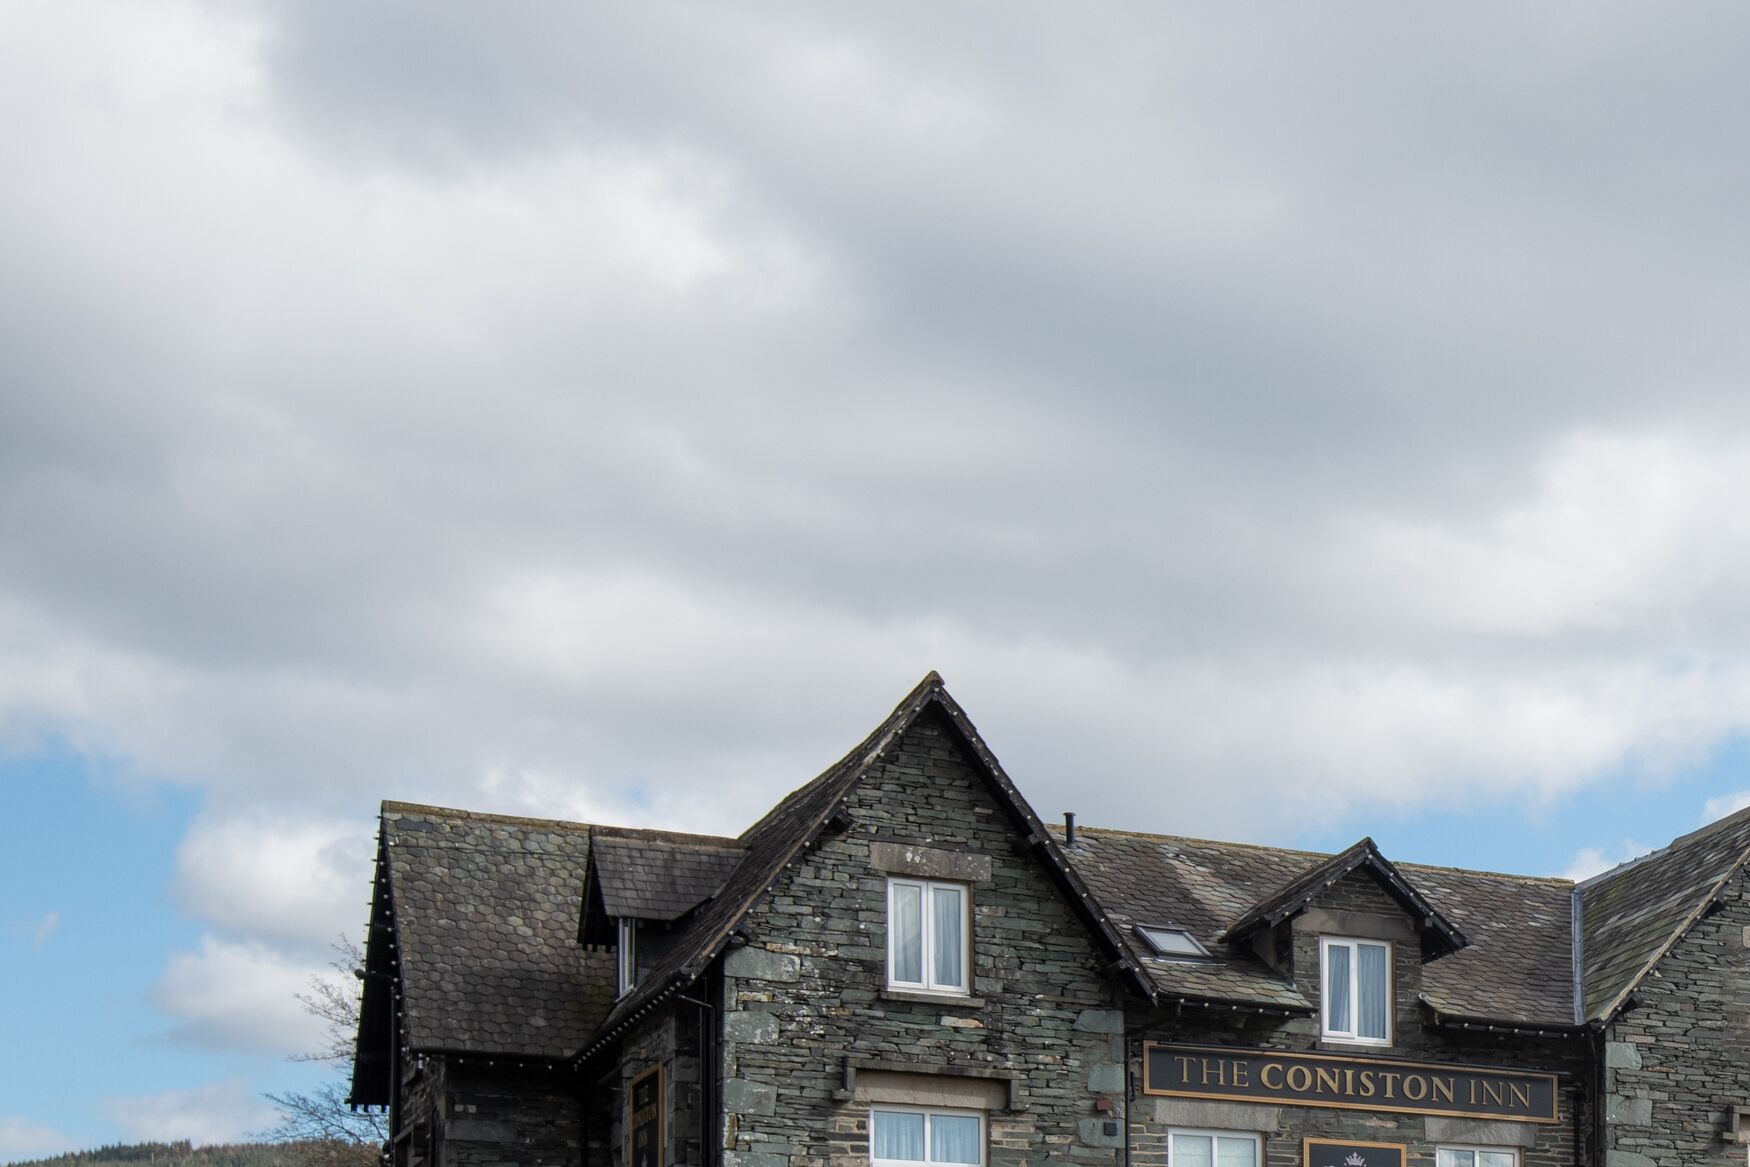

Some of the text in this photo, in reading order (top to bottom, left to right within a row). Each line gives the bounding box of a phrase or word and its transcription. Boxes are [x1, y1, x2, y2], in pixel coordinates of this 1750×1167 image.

[1174, 1056, 1533, 1110] THE CONISTON INN
